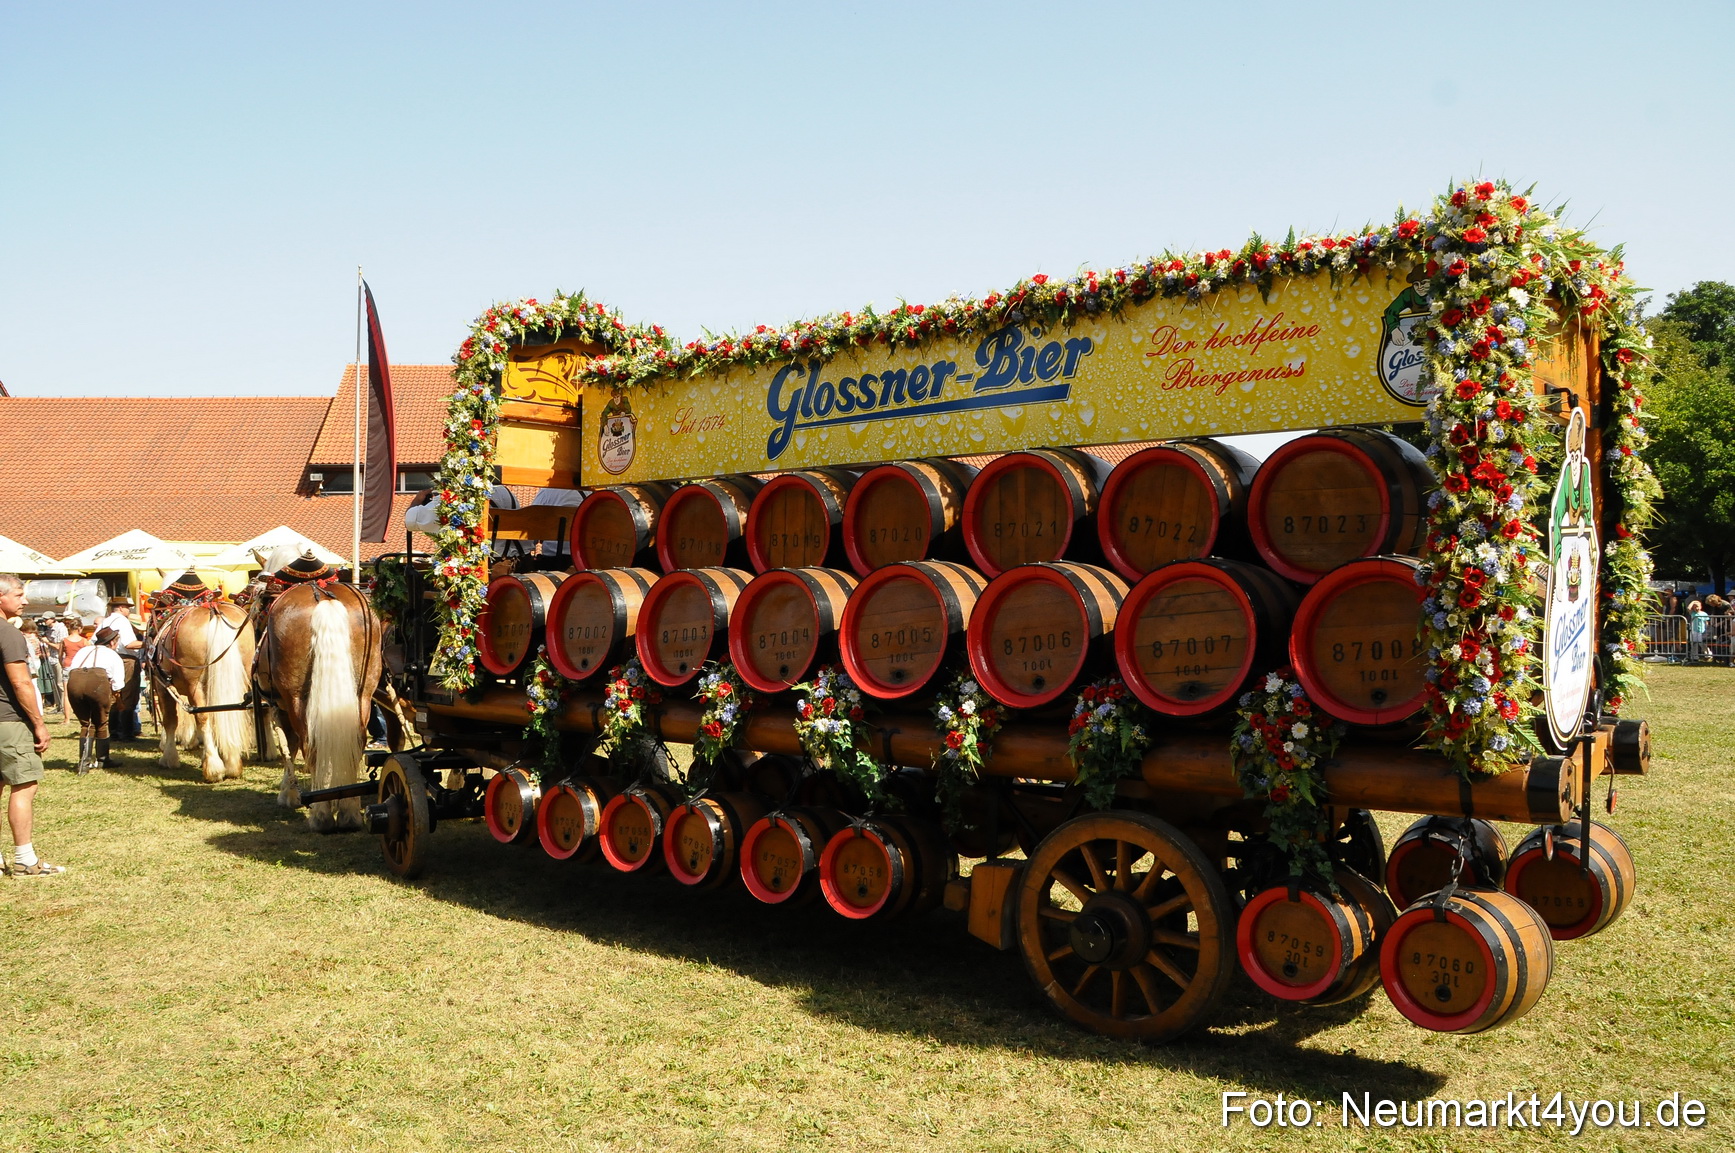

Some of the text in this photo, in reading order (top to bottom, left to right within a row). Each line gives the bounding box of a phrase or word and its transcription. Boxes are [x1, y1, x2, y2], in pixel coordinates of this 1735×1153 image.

[1146, 312, 1321, 357] Der hochfeine
[1388, 348, 1425, 382] Glos
[1161, 358, 1306, 397] Biergenuss
[767, 326, 1095, 461] Glossner-Bier
[669, 406, 727, 436] Seit 1574
[994, 521, 1058, 538] 87021
[1128, 516, 1197, 543] 87022
[1284, 514, 1367, 534] 87023
[771, 532, 821, 548] 87019
[869, 526, 923, 544] 87020
[91, 546, 153, 562] Glossner
[591, 537, 629, 556] 87017
[680, 537, 721, 556] 87018
[497, 623, 530, 638] 87001
[568, 625, 607, 640] 87002
[662, 626, 707, 644] 87003
[759, 628, 809, 649] 87004
[871, 627, 932, 649] 87005
[1553, 597, 1588, 684] Glossner
[1004, 631, 1072, 656] 87006
[1152, 635, 1231, 659] 87007
[1332, 638, 1424, 662] 87008
[683, 835, 710, 855] 87056
[763, 851, 797, 869] 87057
[843, 864, 882, 878] 87058
[1268, 931, 1324, 957] 87059
[1413, 952, 1474, 974] 87060
